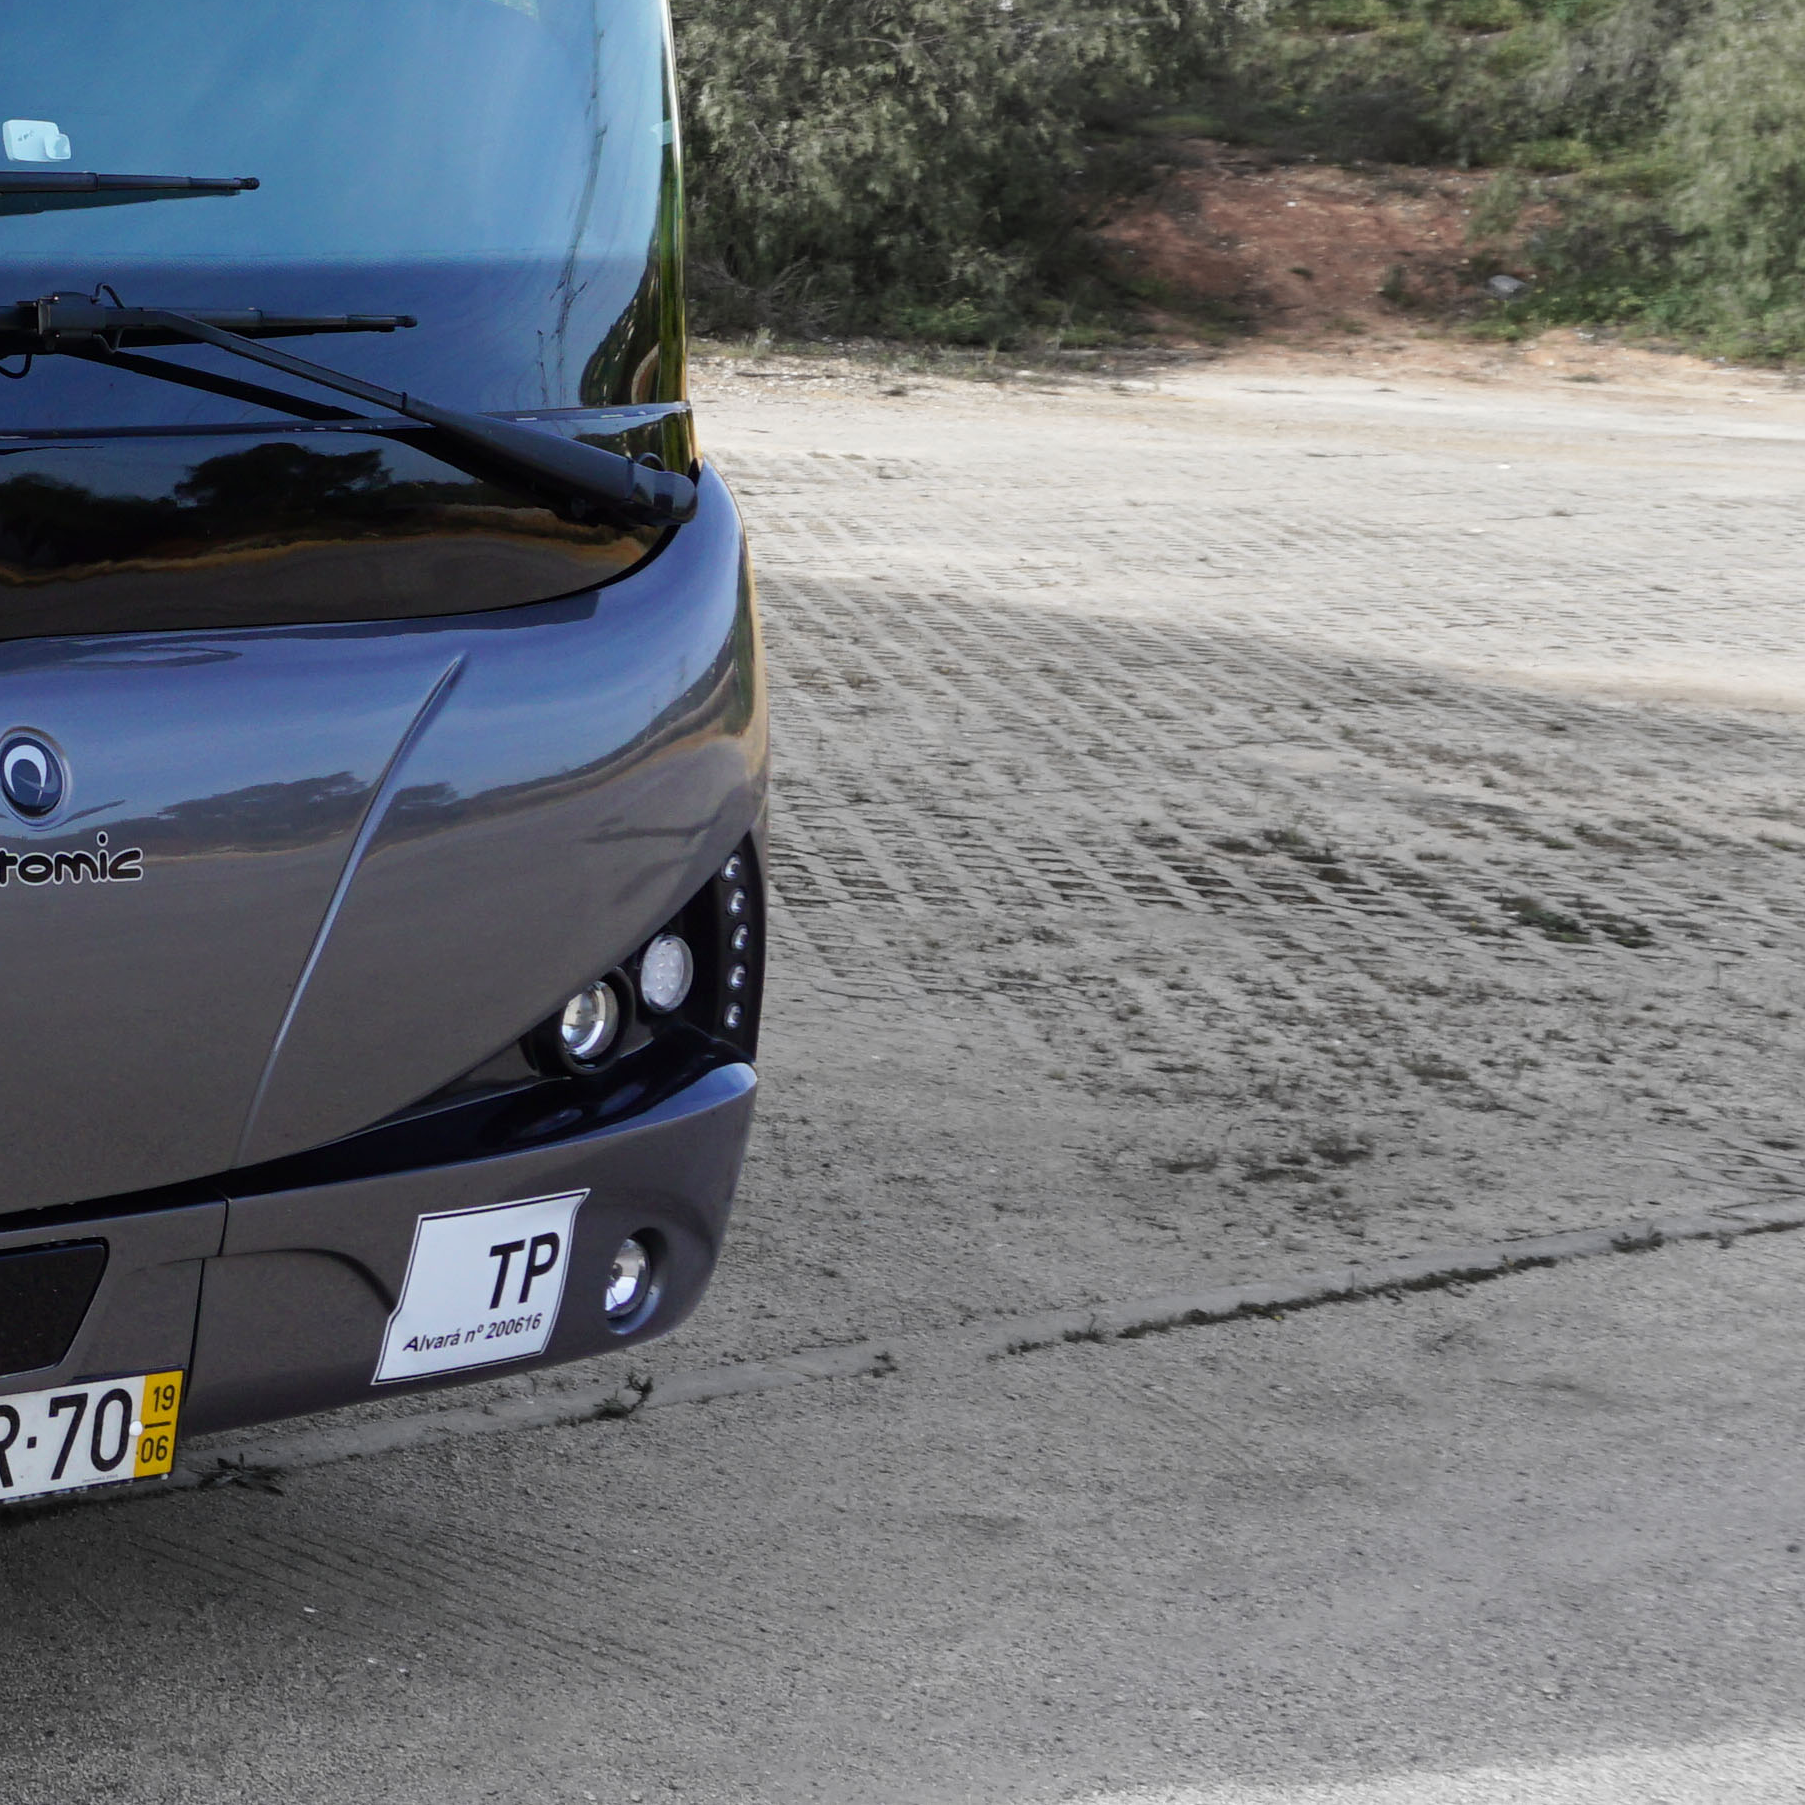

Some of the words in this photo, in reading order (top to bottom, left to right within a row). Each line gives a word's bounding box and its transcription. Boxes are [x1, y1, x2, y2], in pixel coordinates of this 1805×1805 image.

[489, 1231, 561, 1310] TP
[402, 1327, 461, 1352] Alvará
[485, 1312, 543, 1340] 200616
[152, 1383, 175, 1413] 19
[139, 1435, 169, 1464] 06
